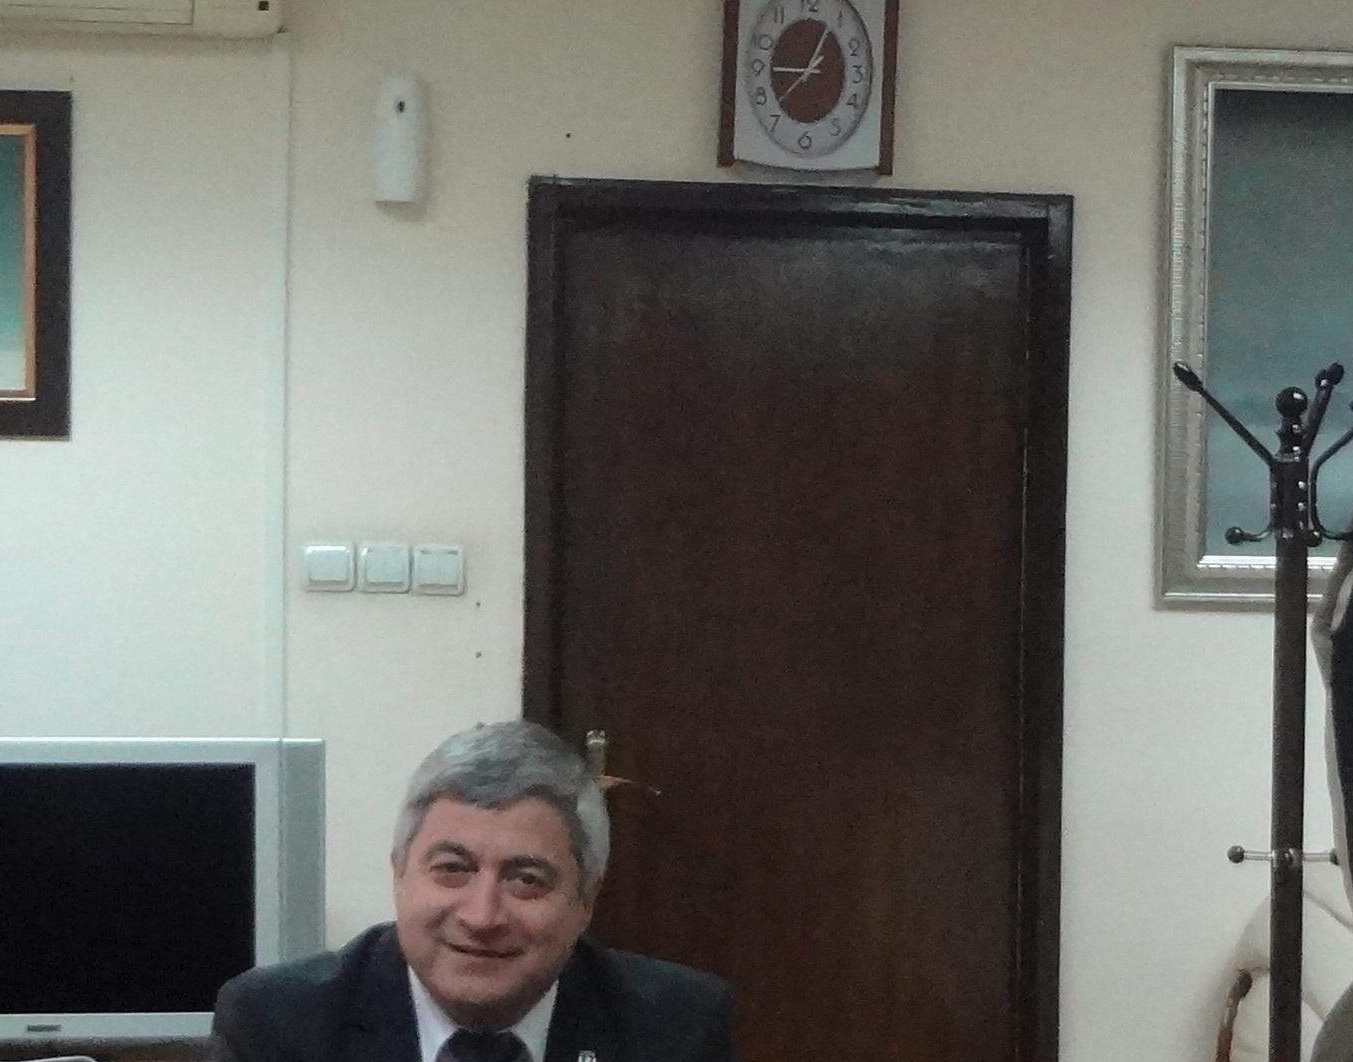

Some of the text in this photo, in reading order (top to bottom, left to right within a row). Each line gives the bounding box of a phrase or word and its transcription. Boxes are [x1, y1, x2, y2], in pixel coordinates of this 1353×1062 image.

[848, 38, 860, 56] 2
[750, 58, 766, 76] 9
[852, 65, 863, 83] 3
[755, 86, 767, 106] 8
[846, 92, 858, 109] 4
[769, 114, 781, 132] 7
[830, 118, 841, 136] 5
[798, 131, 812, 150] 6
